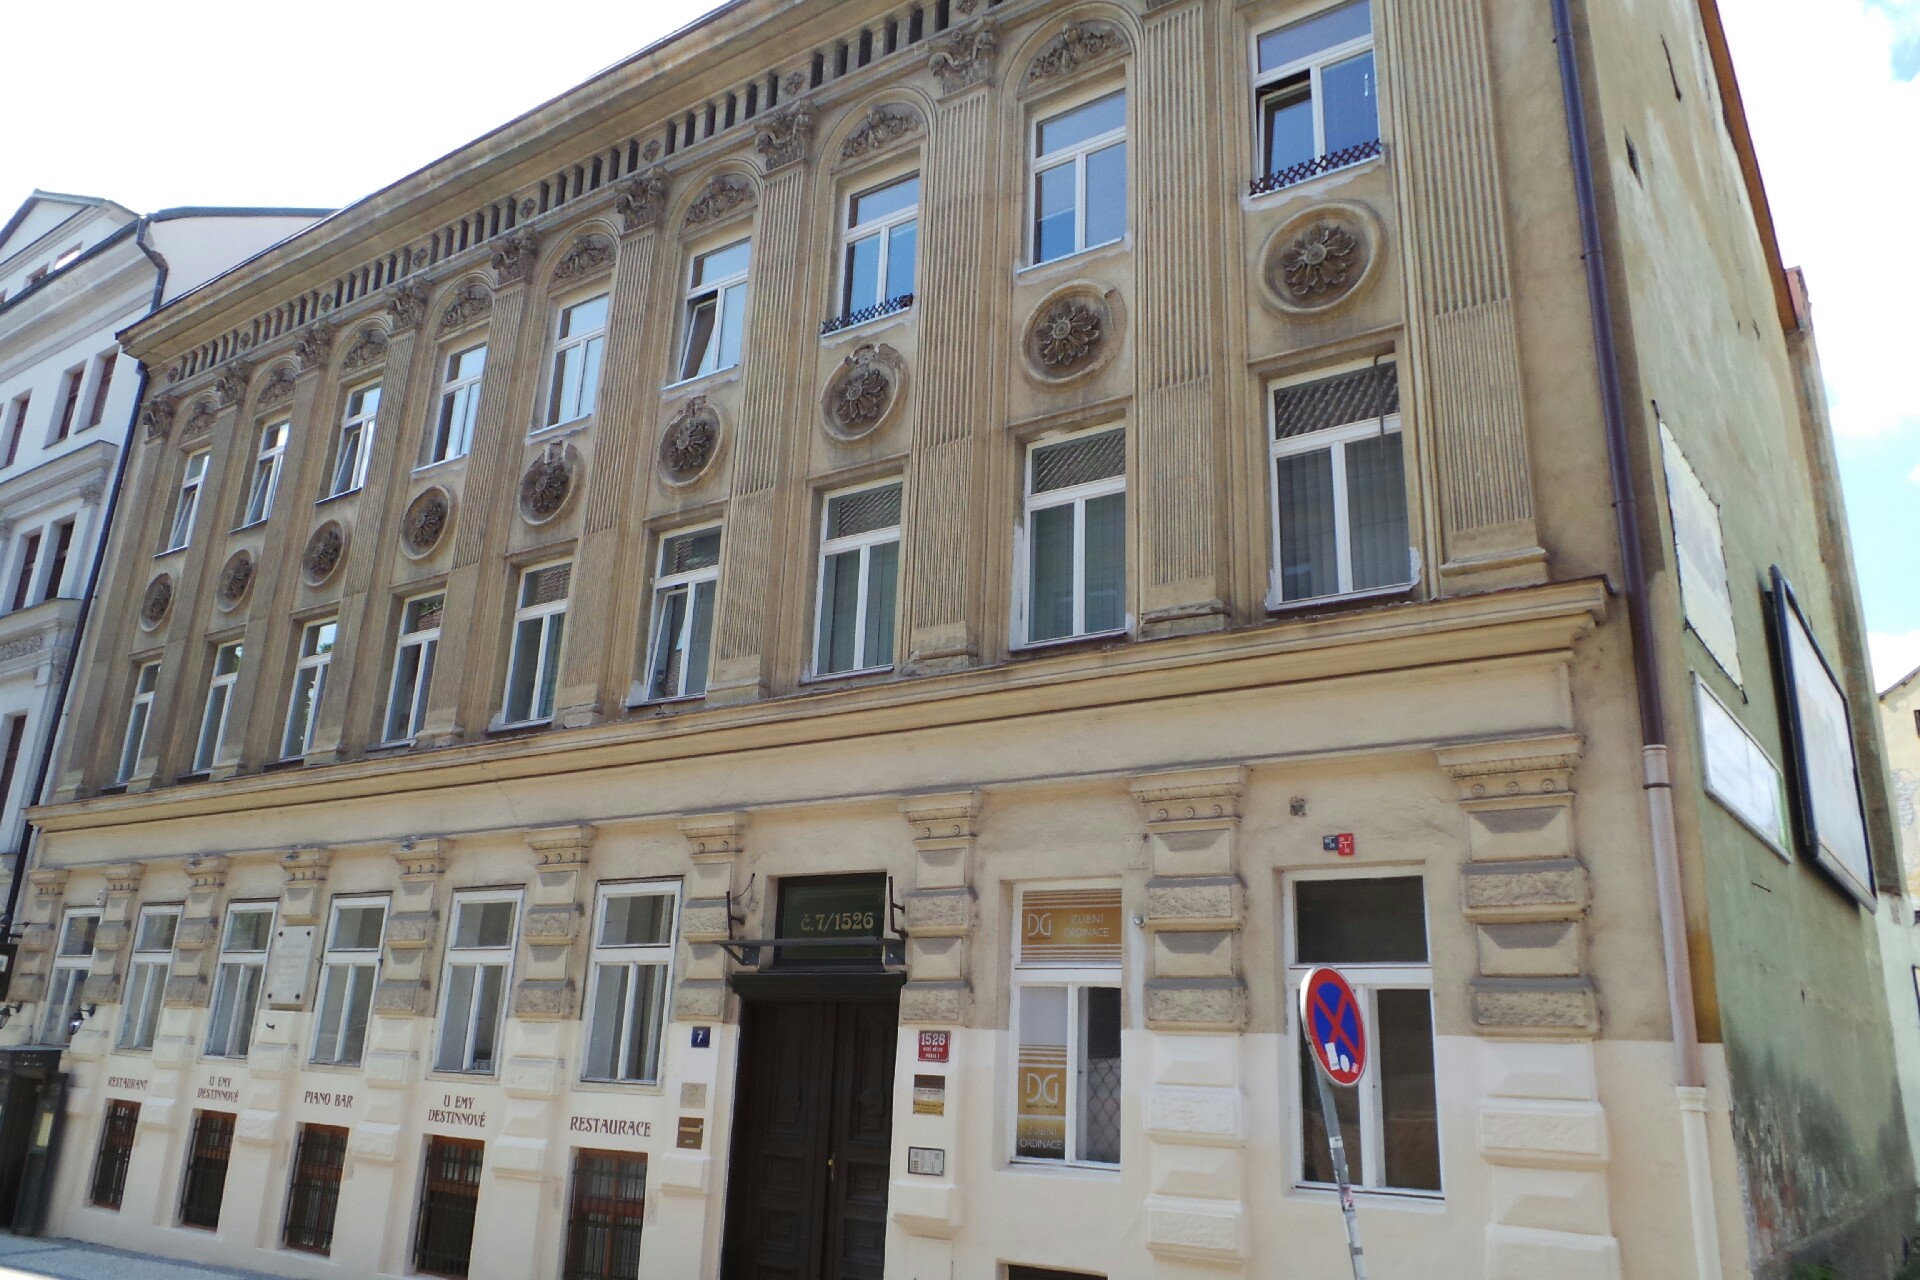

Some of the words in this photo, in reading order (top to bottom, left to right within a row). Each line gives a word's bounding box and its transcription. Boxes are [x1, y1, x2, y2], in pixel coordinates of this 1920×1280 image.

[1063, 927, 1110, 937] ORDINACE
[697, 1030, 704, 1043] 7
[921, 1032, 946, 1046] 1526
[107, 1076, 149, 1091] RESTAURANT
[209, 1076, 216, 1086] U
[218, 1077, 232, 1088] EMY
[197, 1087, 240, 1103] DESTINNOVÉ
[304, 1091, 331, 1106] PIANO
[334, 1094, 354, 1108] BAR
[443, 1094, 451, 1108] U
[455, 1095, 475, 1110] EMY
[428, 1109, 486, 1128] DESTINNOVÉ
[570, 1116, 652, 1138] RESTAURACE
[1020, 1138, 1063, 1150] ORDINACE
